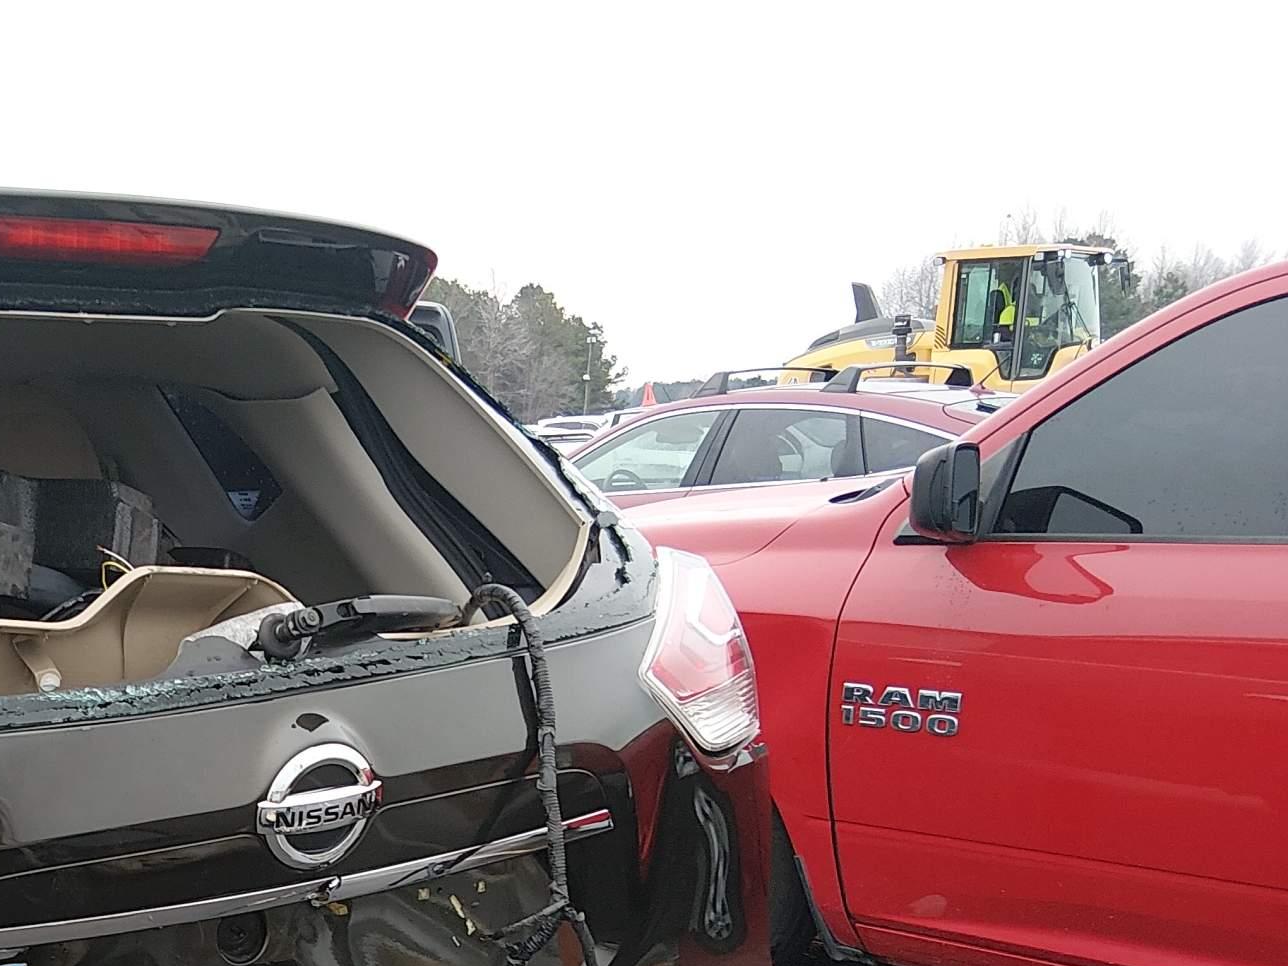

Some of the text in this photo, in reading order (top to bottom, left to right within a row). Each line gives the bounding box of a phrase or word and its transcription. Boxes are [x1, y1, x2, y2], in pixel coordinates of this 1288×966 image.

[841, 682, 962, 713] RAM
[841, 704, 959, 737] 1500
[274, 791, 376, 829] NISSAN
